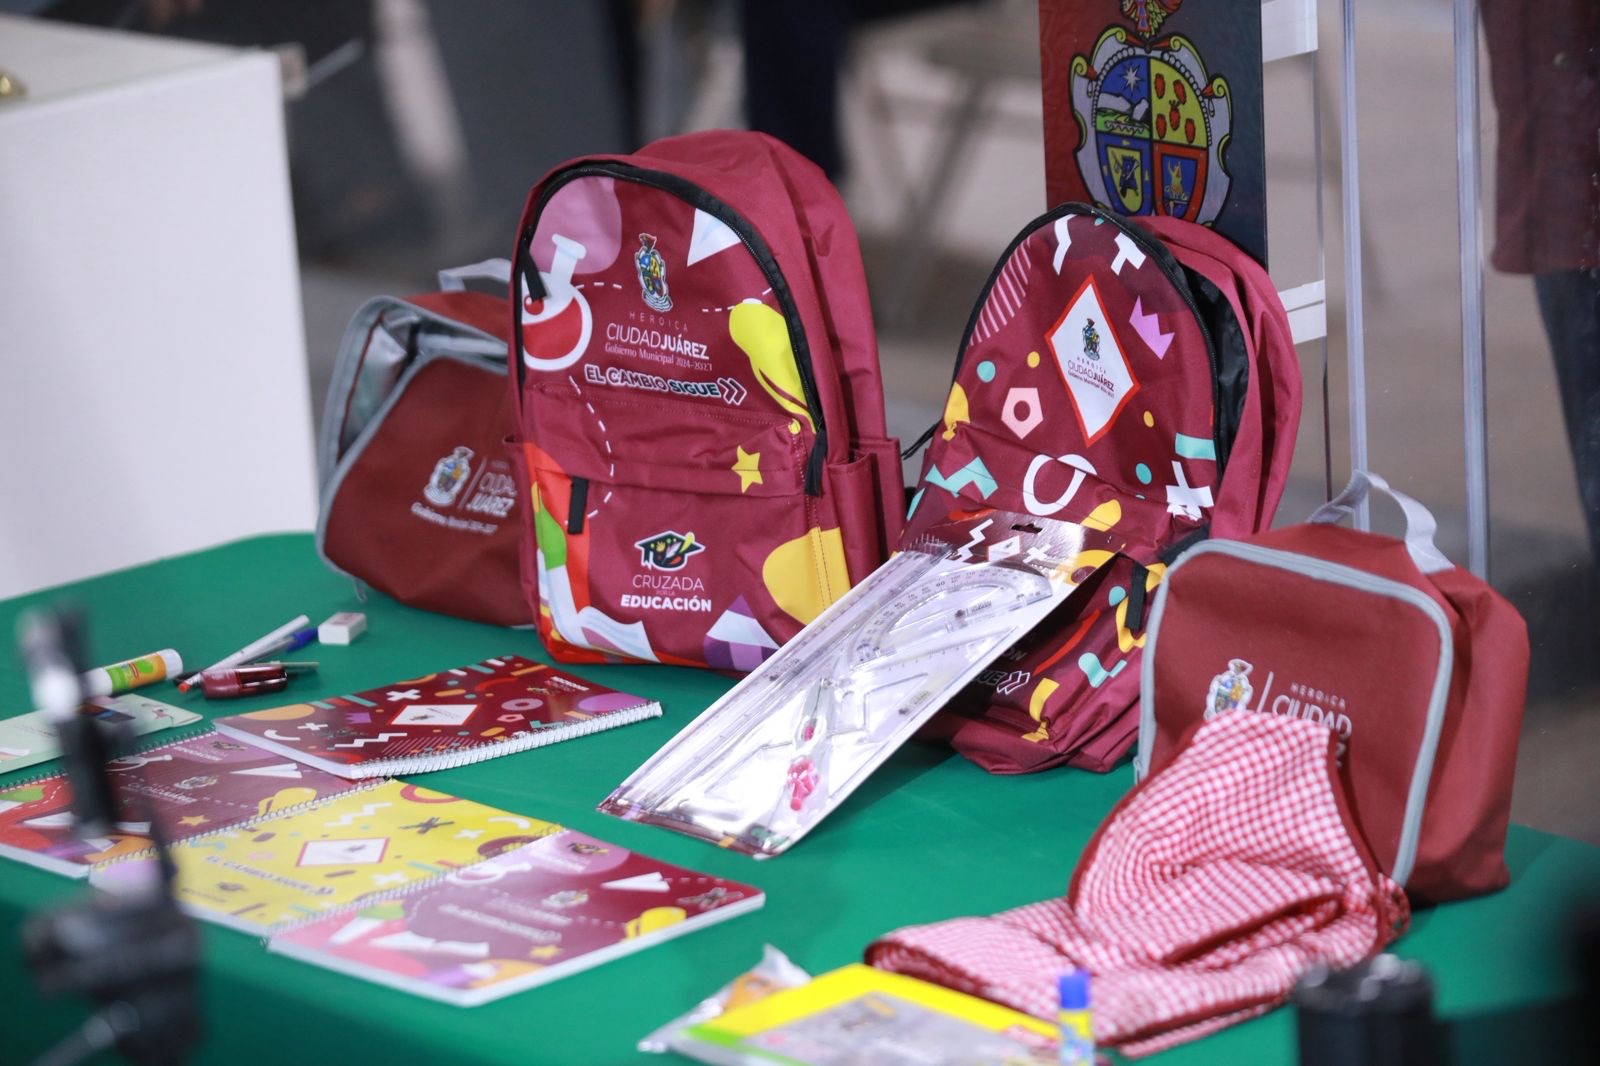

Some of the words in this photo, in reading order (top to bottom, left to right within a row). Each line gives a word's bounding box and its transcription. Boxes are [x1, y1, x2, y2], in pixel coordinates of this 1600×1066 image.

[629, 311, 688, 332] HEROICA
[605, 342, 637, 357] Gobierno
[640, 348, 674, 365] Municipal
[585, 365, 605, 382] EL
[606, 367, 669, 391] CAMBIO
[669, 380, 721, 397] SIGUE
[632, 574, 705, 591] CRUZADA
[620, 594, 712, 612] EDUCACIÓN
[1290, 682, 1346, 709] HEROICA
